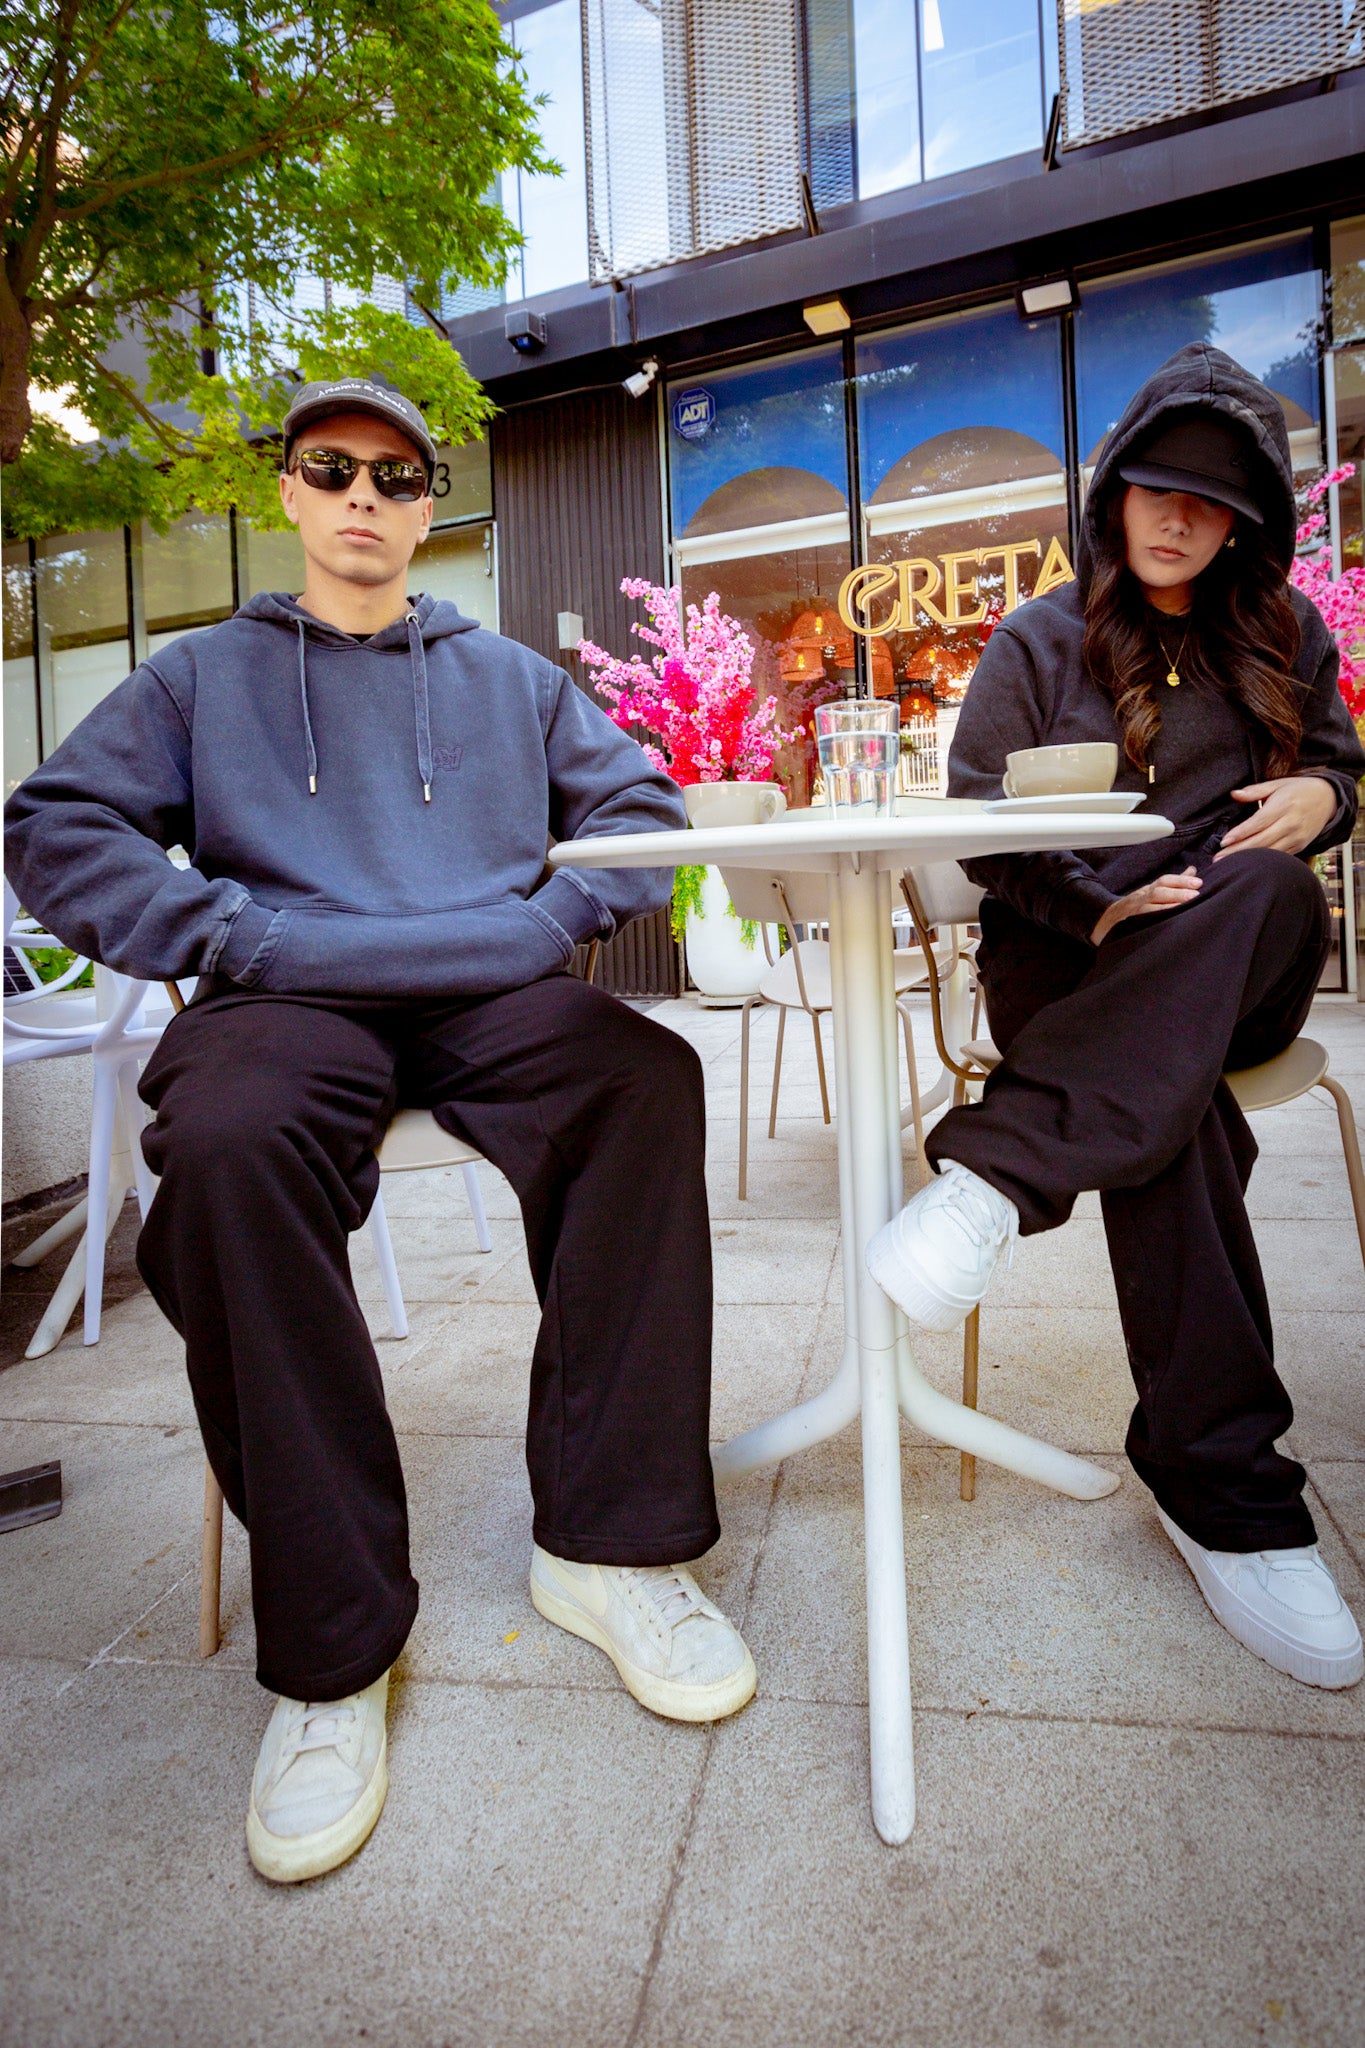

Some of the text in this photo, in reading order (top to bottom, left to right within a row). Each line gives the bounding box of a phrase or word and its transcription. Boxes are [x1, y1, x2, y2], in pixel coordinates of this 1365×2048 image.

[680, 401, 709, 424] ADT
[432, 463, 451, 498] 3
[838, 536, 1077, 637] CRETA
